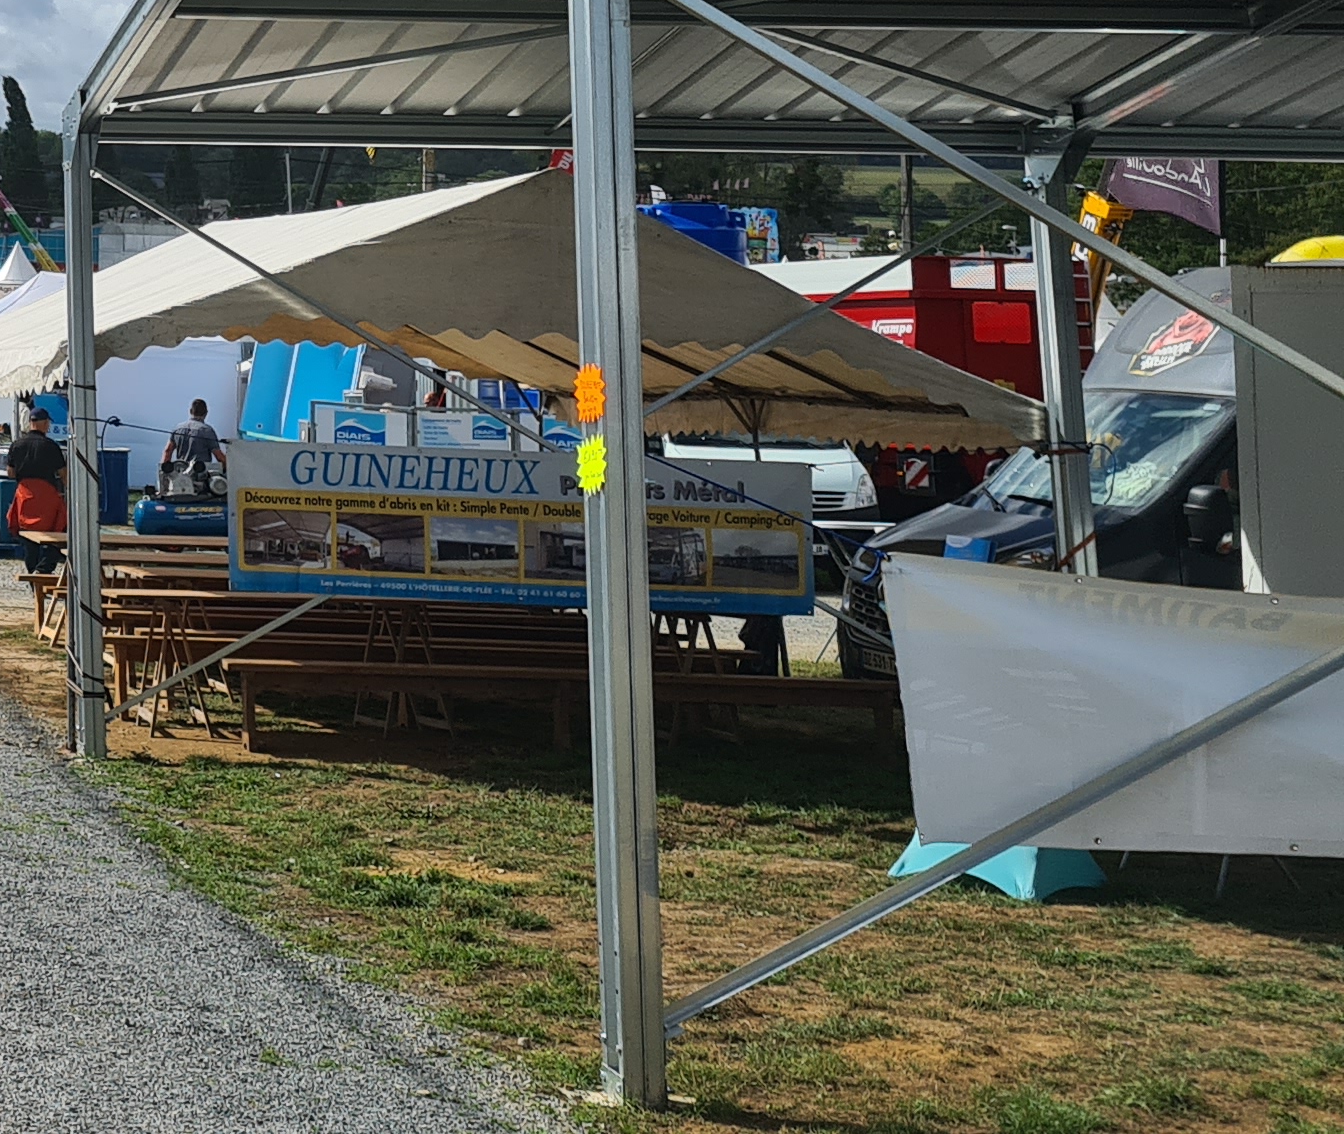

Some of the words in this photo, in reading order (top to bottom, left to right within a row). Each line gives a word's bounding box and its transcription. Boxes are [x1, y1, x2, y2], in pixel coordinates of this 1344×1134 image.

[872, 318, 914, 337] Krampe
[290, 450, 541, 495] GUINEHEUX
[673, 480, 745, 504] Métal
[244, 491, 301, 506] Découvrez
[304, 496, 333, 507] notre
[335, 499, 375, 511] gamme
[379, 497, 417, 511] d'abris
[420, 502, 433, 512] en
[436, 499, 450, 512] kit
[460, 500, 497, 516] Simple
[499, 503, 529, 515] Pente
[542, 504, 582, 518] Double
[671, 511, 711, 524] Voiture
[724, 513, 797, 529] Camping-Car
[320, 579, 334, 587] Les
[335, 579, 372, 589] Perrières
[380, 582, 407, 591] 49500
[529, 589, 540, 597] 41
[542, 590, 554, 598] 61
[555, 590, 568, 598] 60
[569, 591, 581, 599] 60
